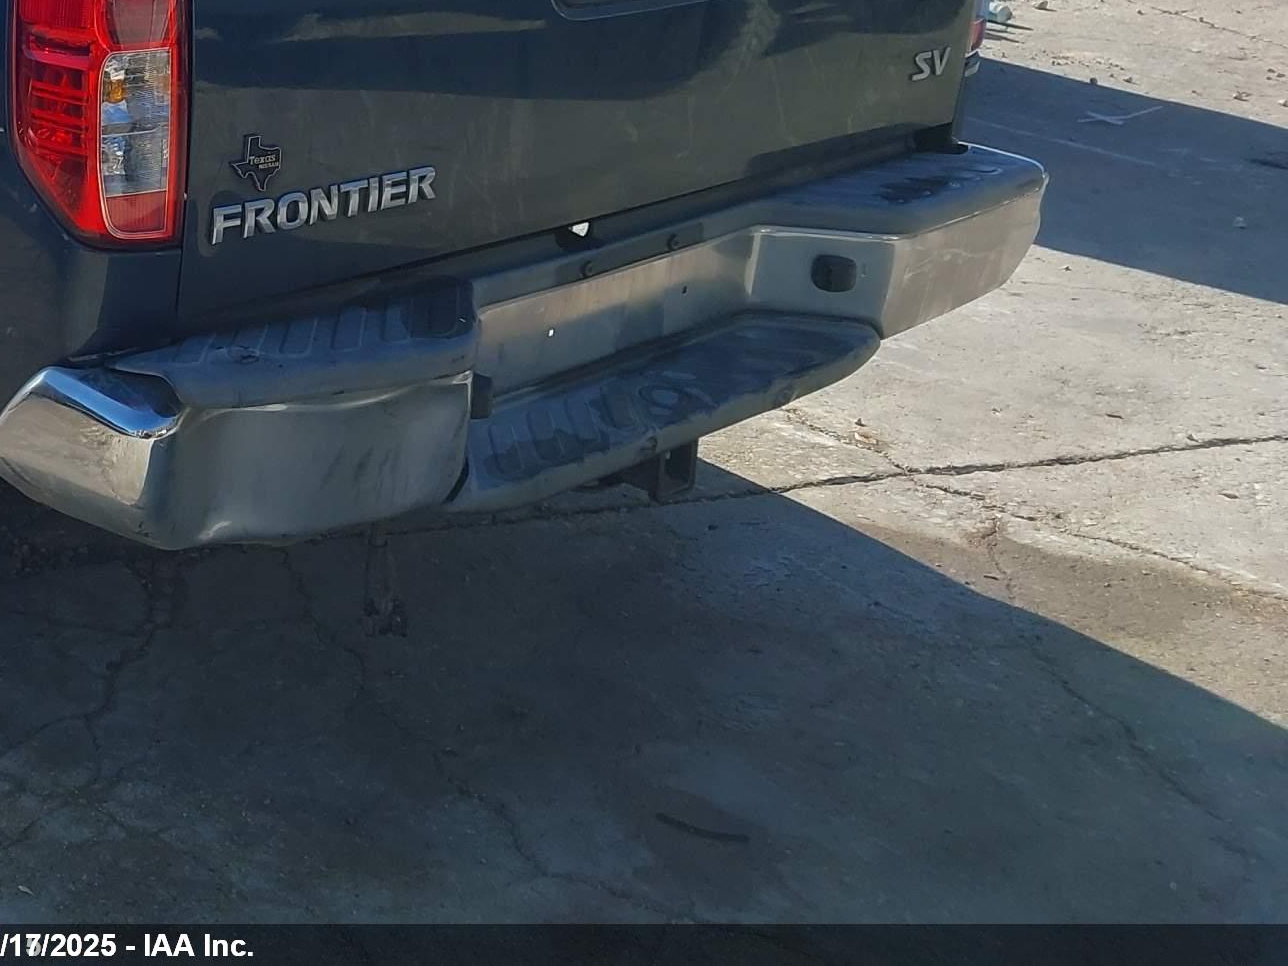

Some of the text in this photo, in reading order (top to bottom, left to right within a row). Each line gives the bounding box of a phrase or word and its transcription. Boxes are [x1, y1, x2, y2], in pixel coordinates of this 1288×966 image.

[911, 47, 952, 81] SV
[249, 154, 277, 165] Texas
[211, 166, 437, 246] FRONTIER
